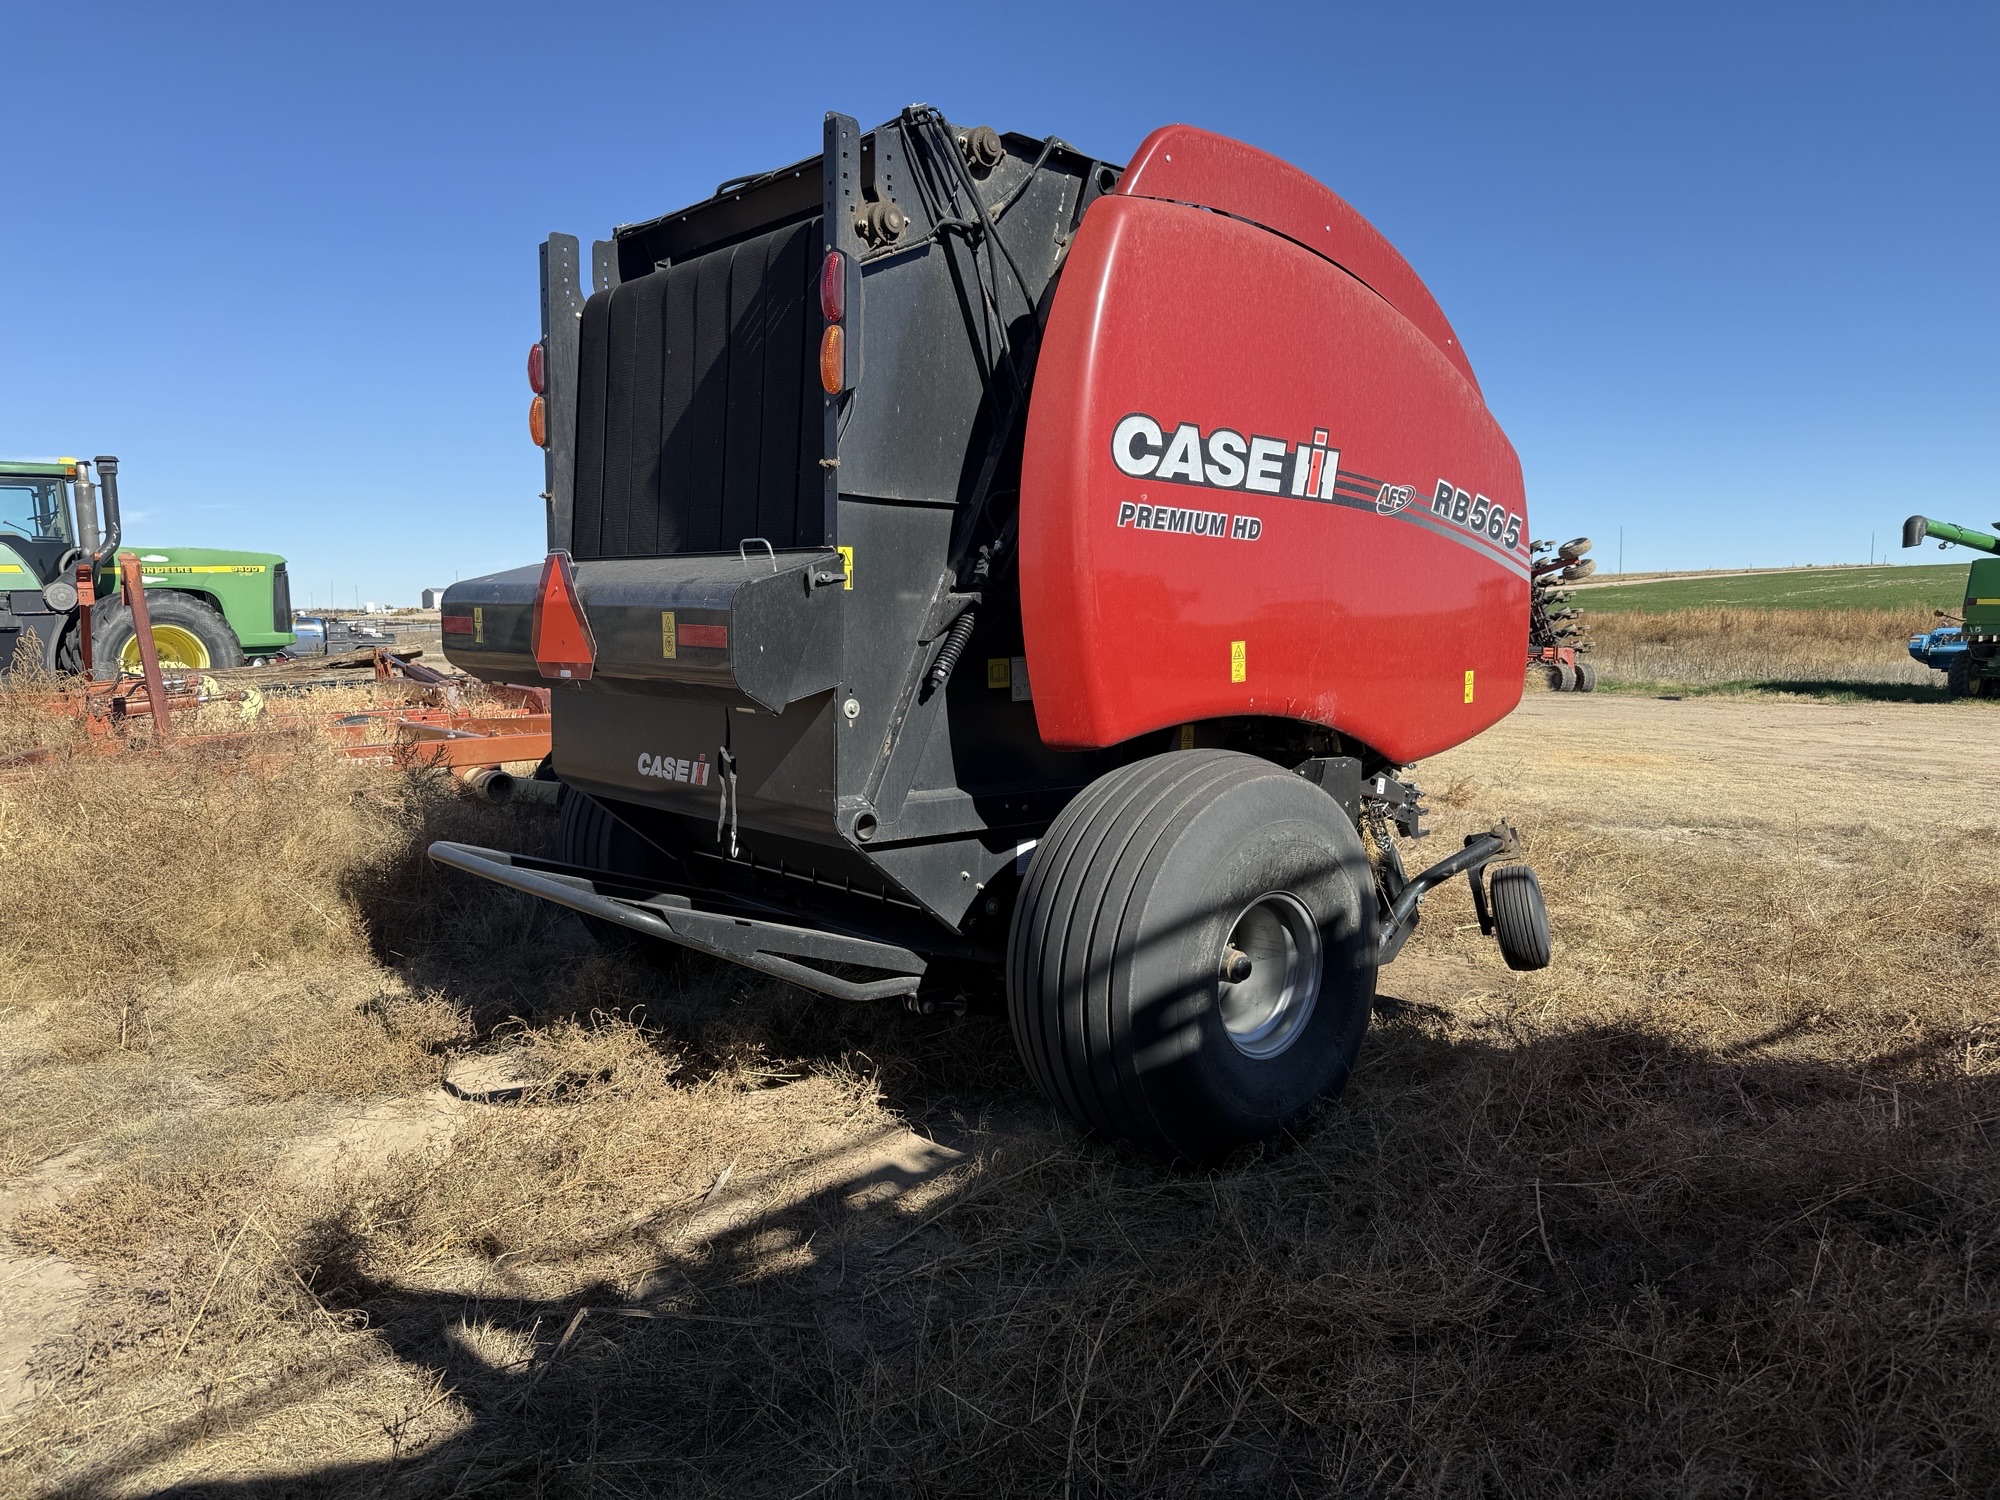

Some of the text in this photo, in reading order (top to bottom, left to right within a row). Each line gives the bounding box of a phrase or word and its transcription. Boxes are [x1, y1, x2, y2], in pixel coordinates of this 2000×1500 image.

[1111, 413, 1288, 493] CASE
[1376, 483, 1408, 509] AFS
[1431, 478, 1523, 551] RB565
[1117, 501, 1262, 541] PREMIUM HD
[637, 752, 690, 783] CASE
